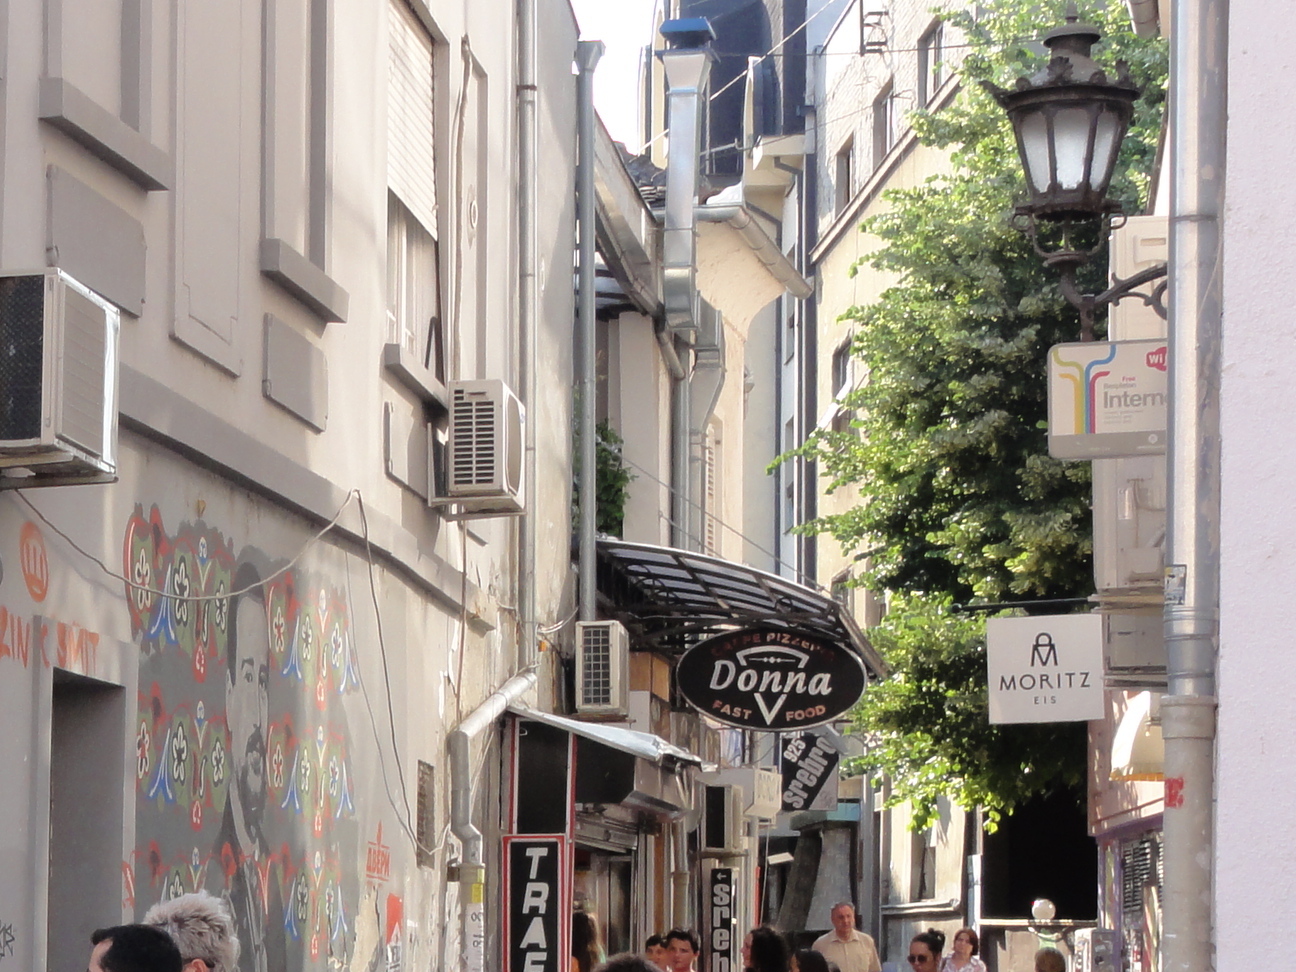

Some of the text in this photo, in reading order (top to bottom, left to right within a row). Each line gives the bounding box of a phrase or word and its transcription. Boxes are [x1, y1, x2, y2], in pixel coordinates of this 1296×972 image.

[709, 660, 832, 696] Donna
[999, 671, 1090, 691] MORITZ
[712, 700, 826, 722] FAST FOOD
[1033, 696, 1057, 705] EIS
[783, 737, 806, 763] 925
[783, 736, 837, 809] srebro
